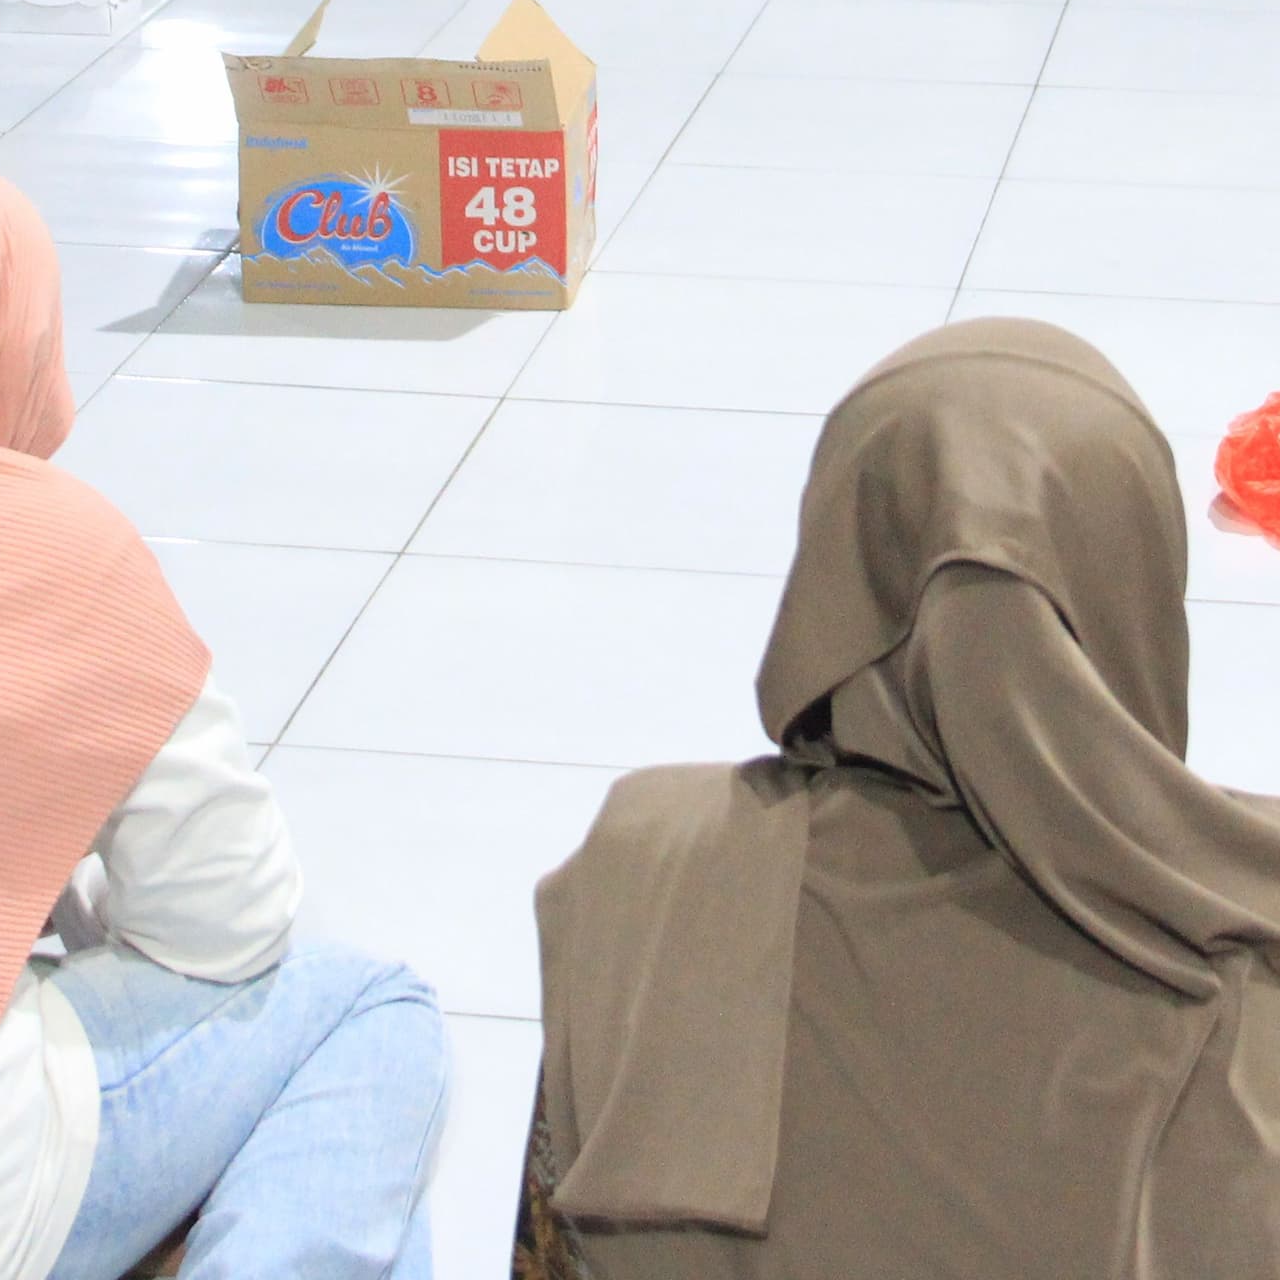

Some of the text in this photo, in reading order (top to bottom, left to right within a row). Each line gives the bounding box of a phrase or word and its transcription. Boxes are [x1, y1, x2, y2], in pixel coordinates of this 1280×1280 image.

[448, 156, 560, 179] ISI TETAP
[276, 189, 392, 244] Club
[464, 186, 537, 227] 48
[473, 229, 537, 253] CUP
